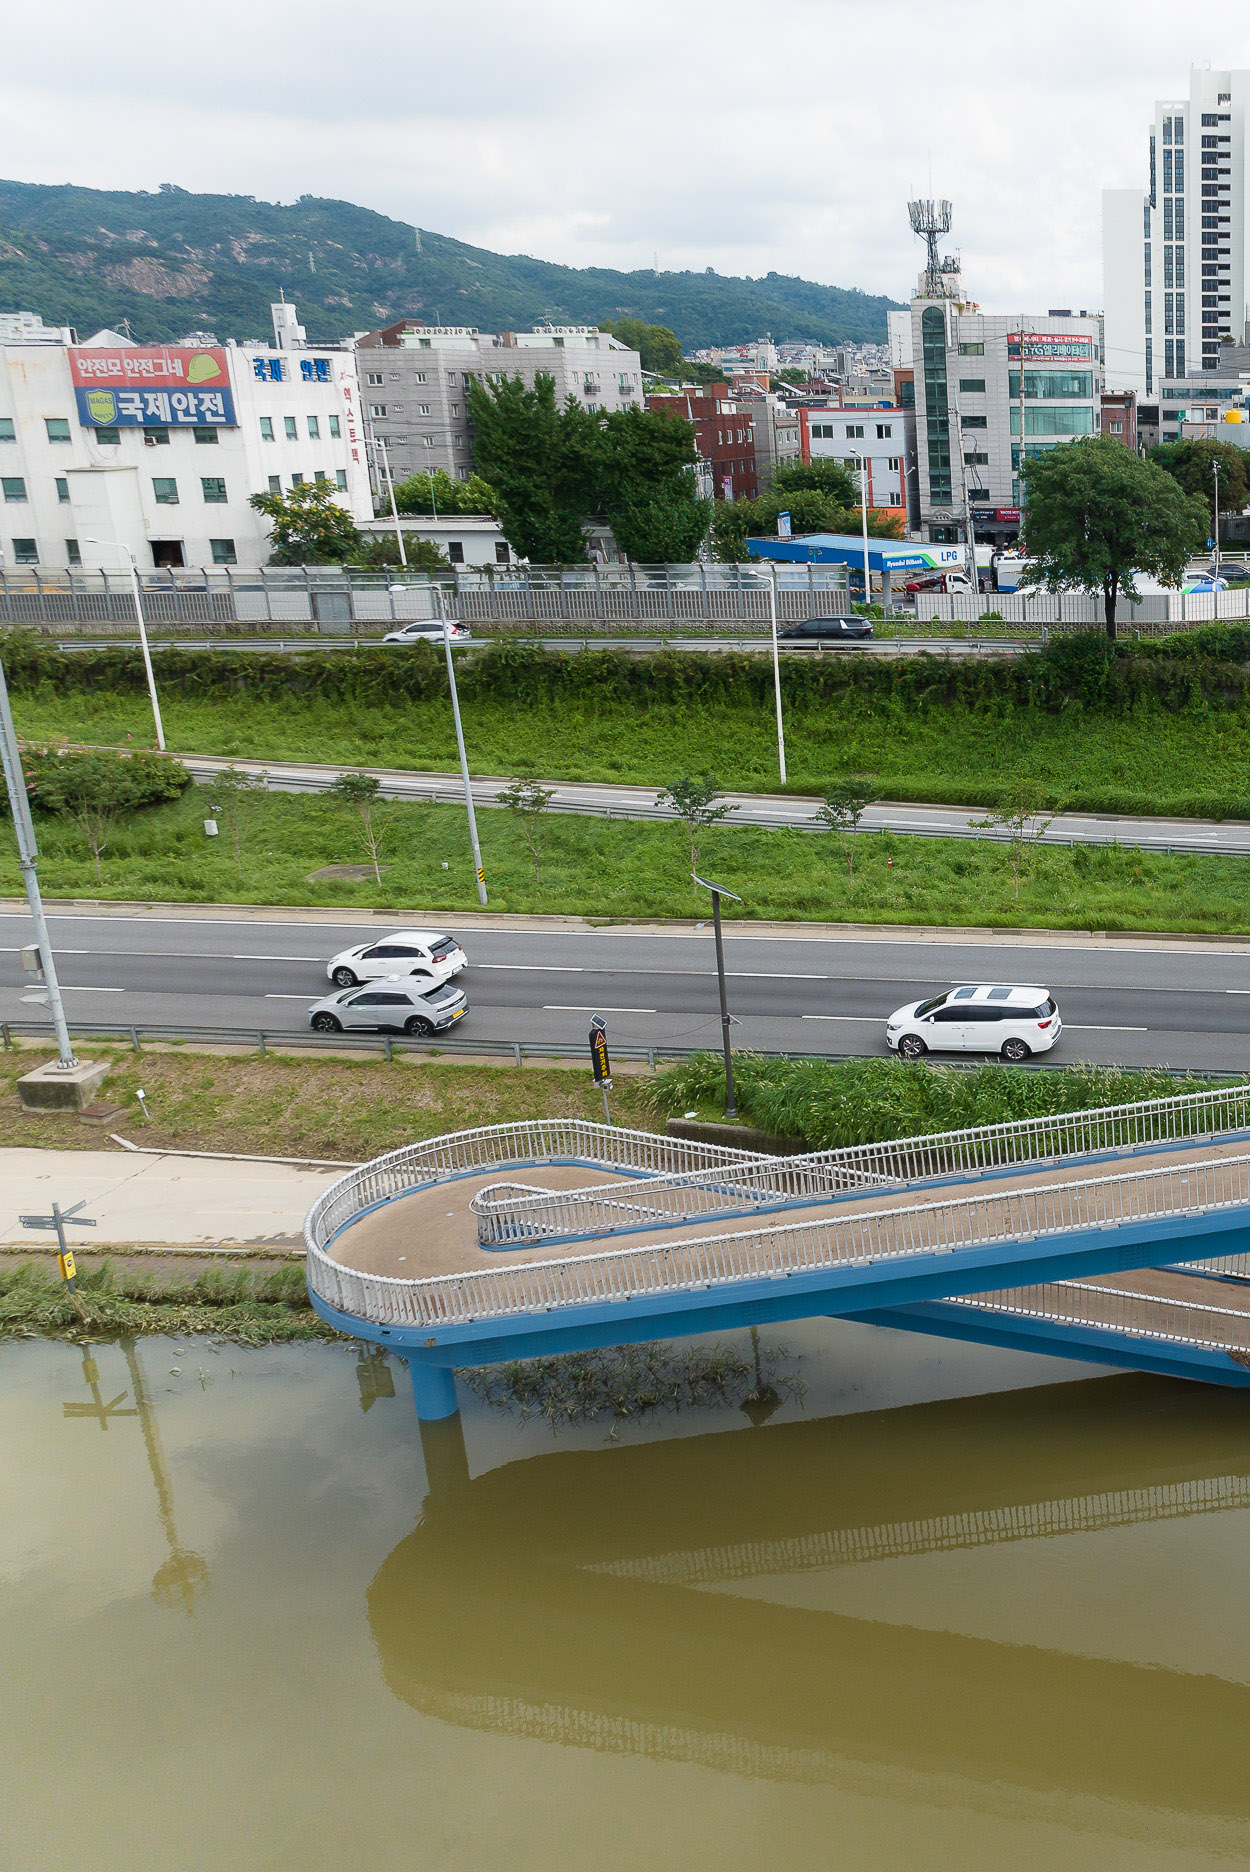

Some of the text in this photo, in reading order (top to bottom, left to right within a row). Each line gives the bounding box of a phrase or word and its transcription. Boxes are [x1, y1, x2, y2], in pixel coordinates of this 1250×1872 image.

[76, 358, 184, 378] 안전모 안전그네
[300, 359, 328, 382] 안전
[118, 392, 227, 422] 국제안전
[941, 551, 958, 562] LPG
